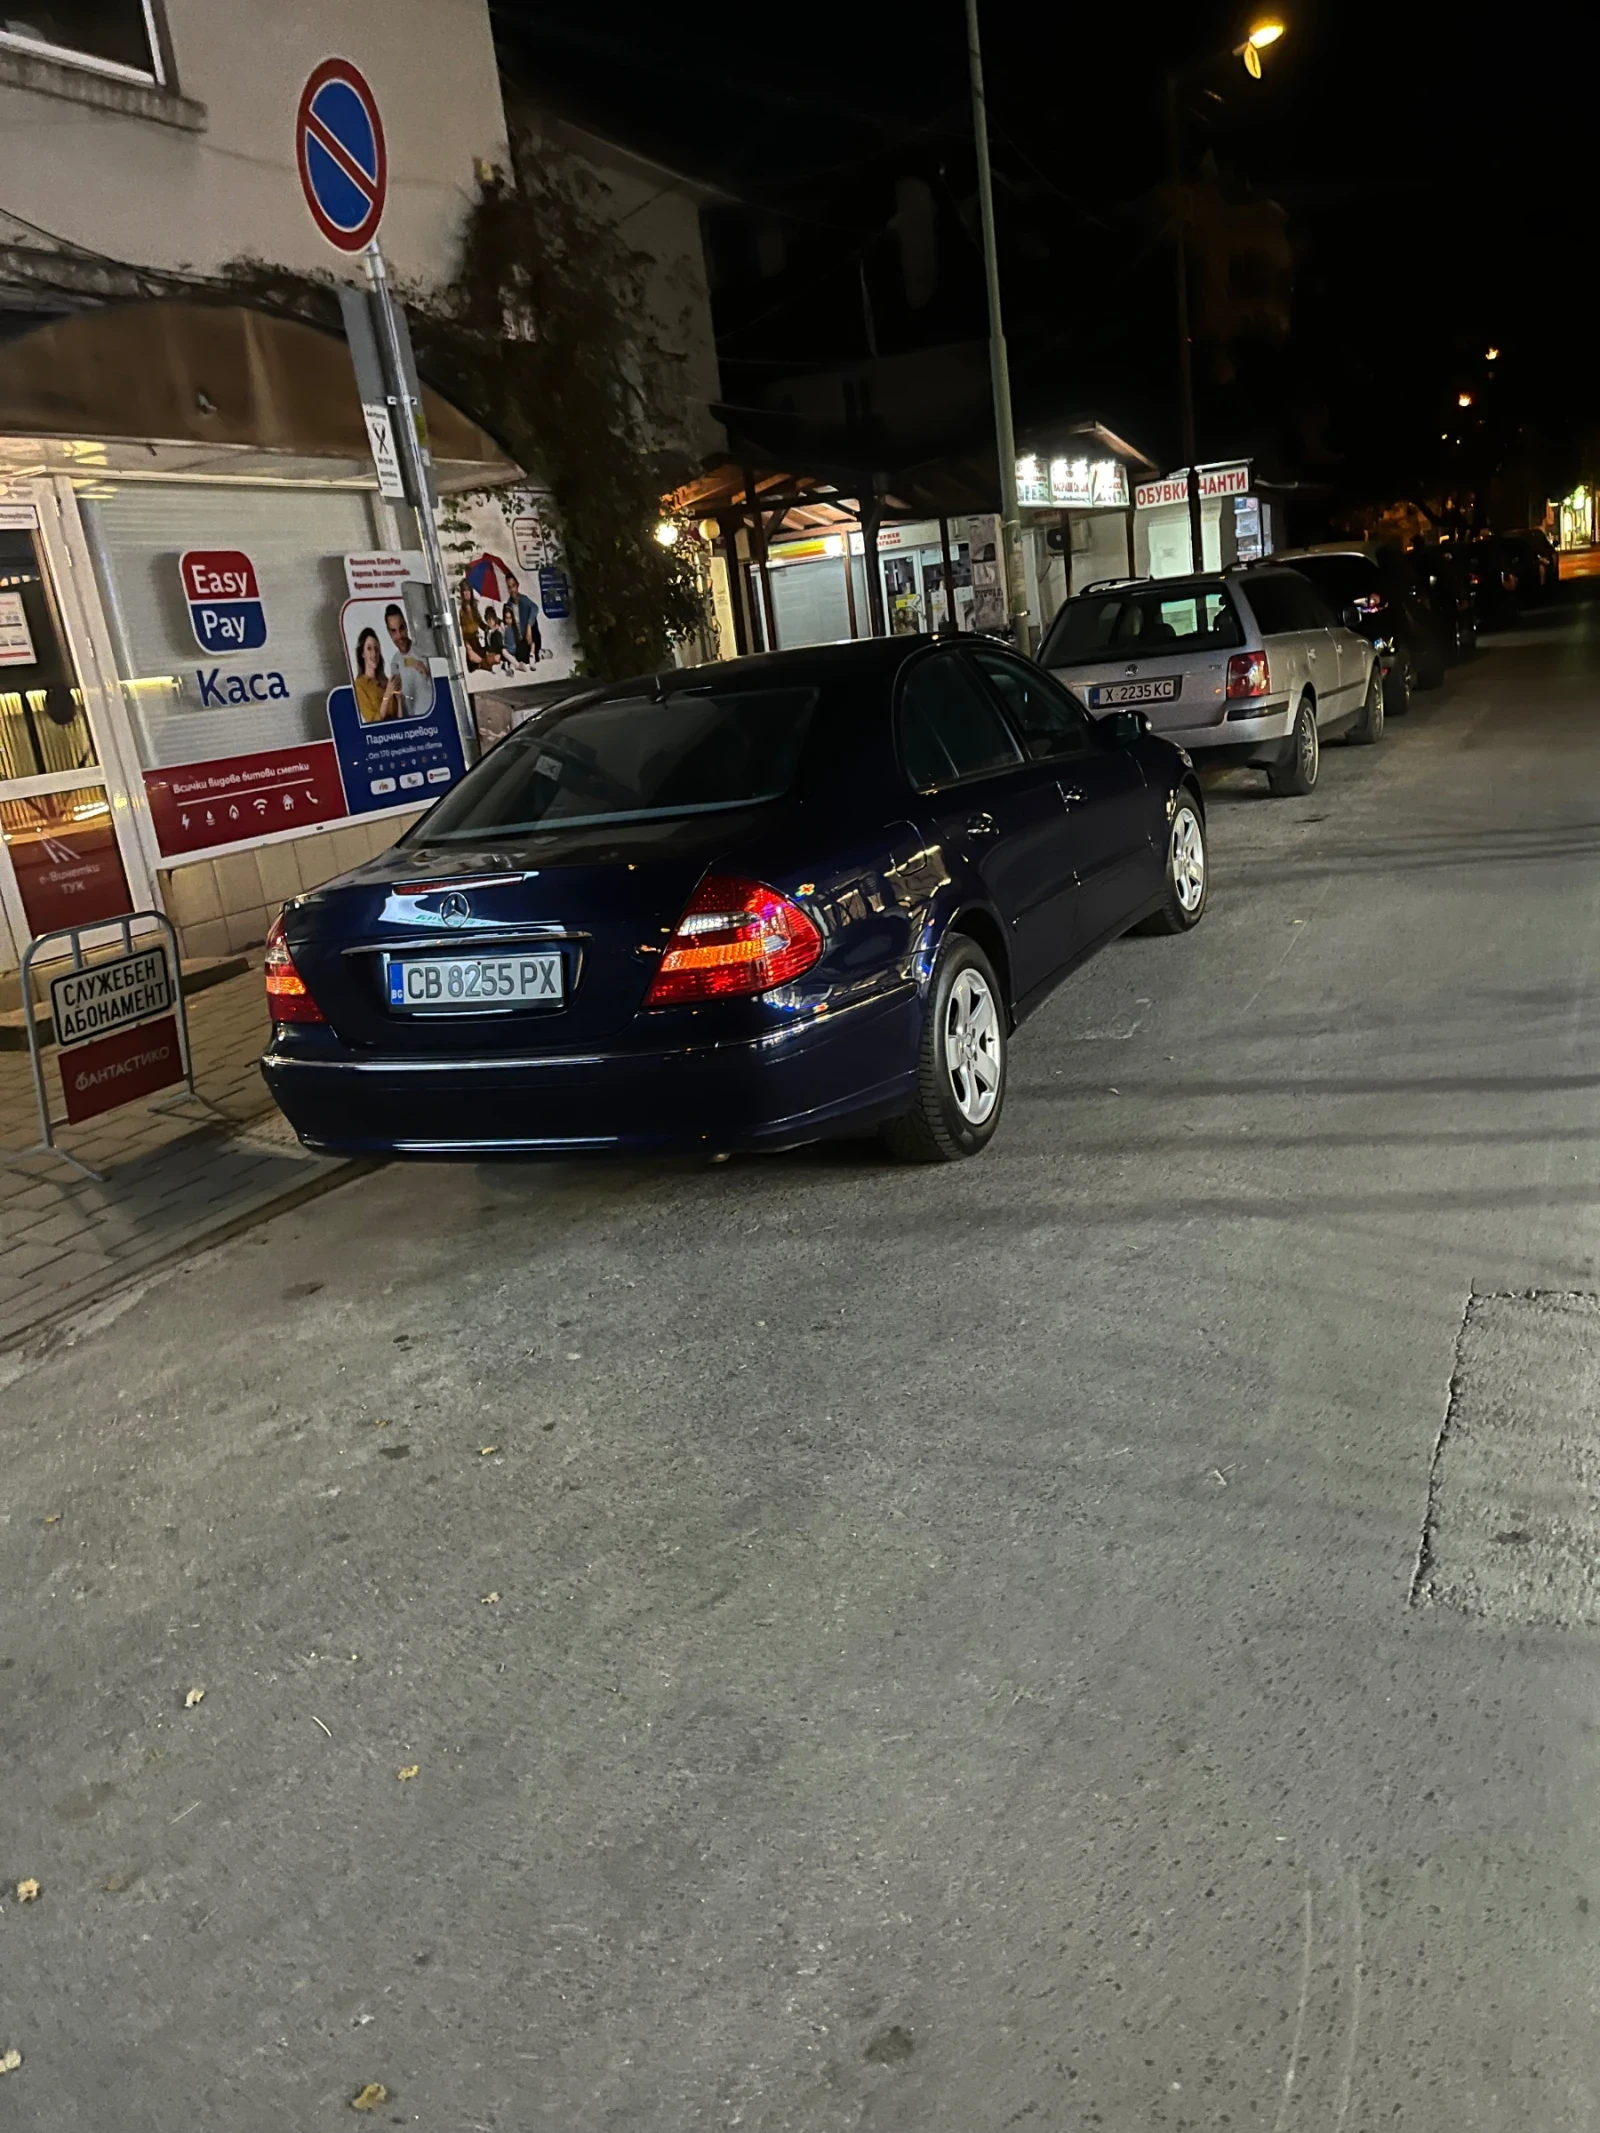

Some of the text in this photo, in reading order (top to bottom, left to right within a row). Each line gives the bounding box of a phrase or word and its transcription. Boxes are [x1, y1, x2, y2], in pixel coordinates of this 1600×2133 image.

[1137, 472, 1246, 506] ОБУВКИ ЧАНТИ
[191, 564, 247, 597] Easy
[201, 610, 245, 643] Pay
[196, 668, 290, 708] Каса
[1105, 681, 1172, 702] X 2235 KC
[366, 726, 438, 745] Парични преводи
[173, 762, 310, 794] Всички видове битови сметки
[61, 880, 86, 894] ТУК
[63, 957, 157, 1008] СЛУЖЕБЕН
[391, 989, 403, 999] BG
[407, 959, 556, 999] CB 8255 PX
[64, 981, 164, 1037] АБОНАМЕНТ
[75, 1045, 170, 1091] ФАНТАСТИКО
